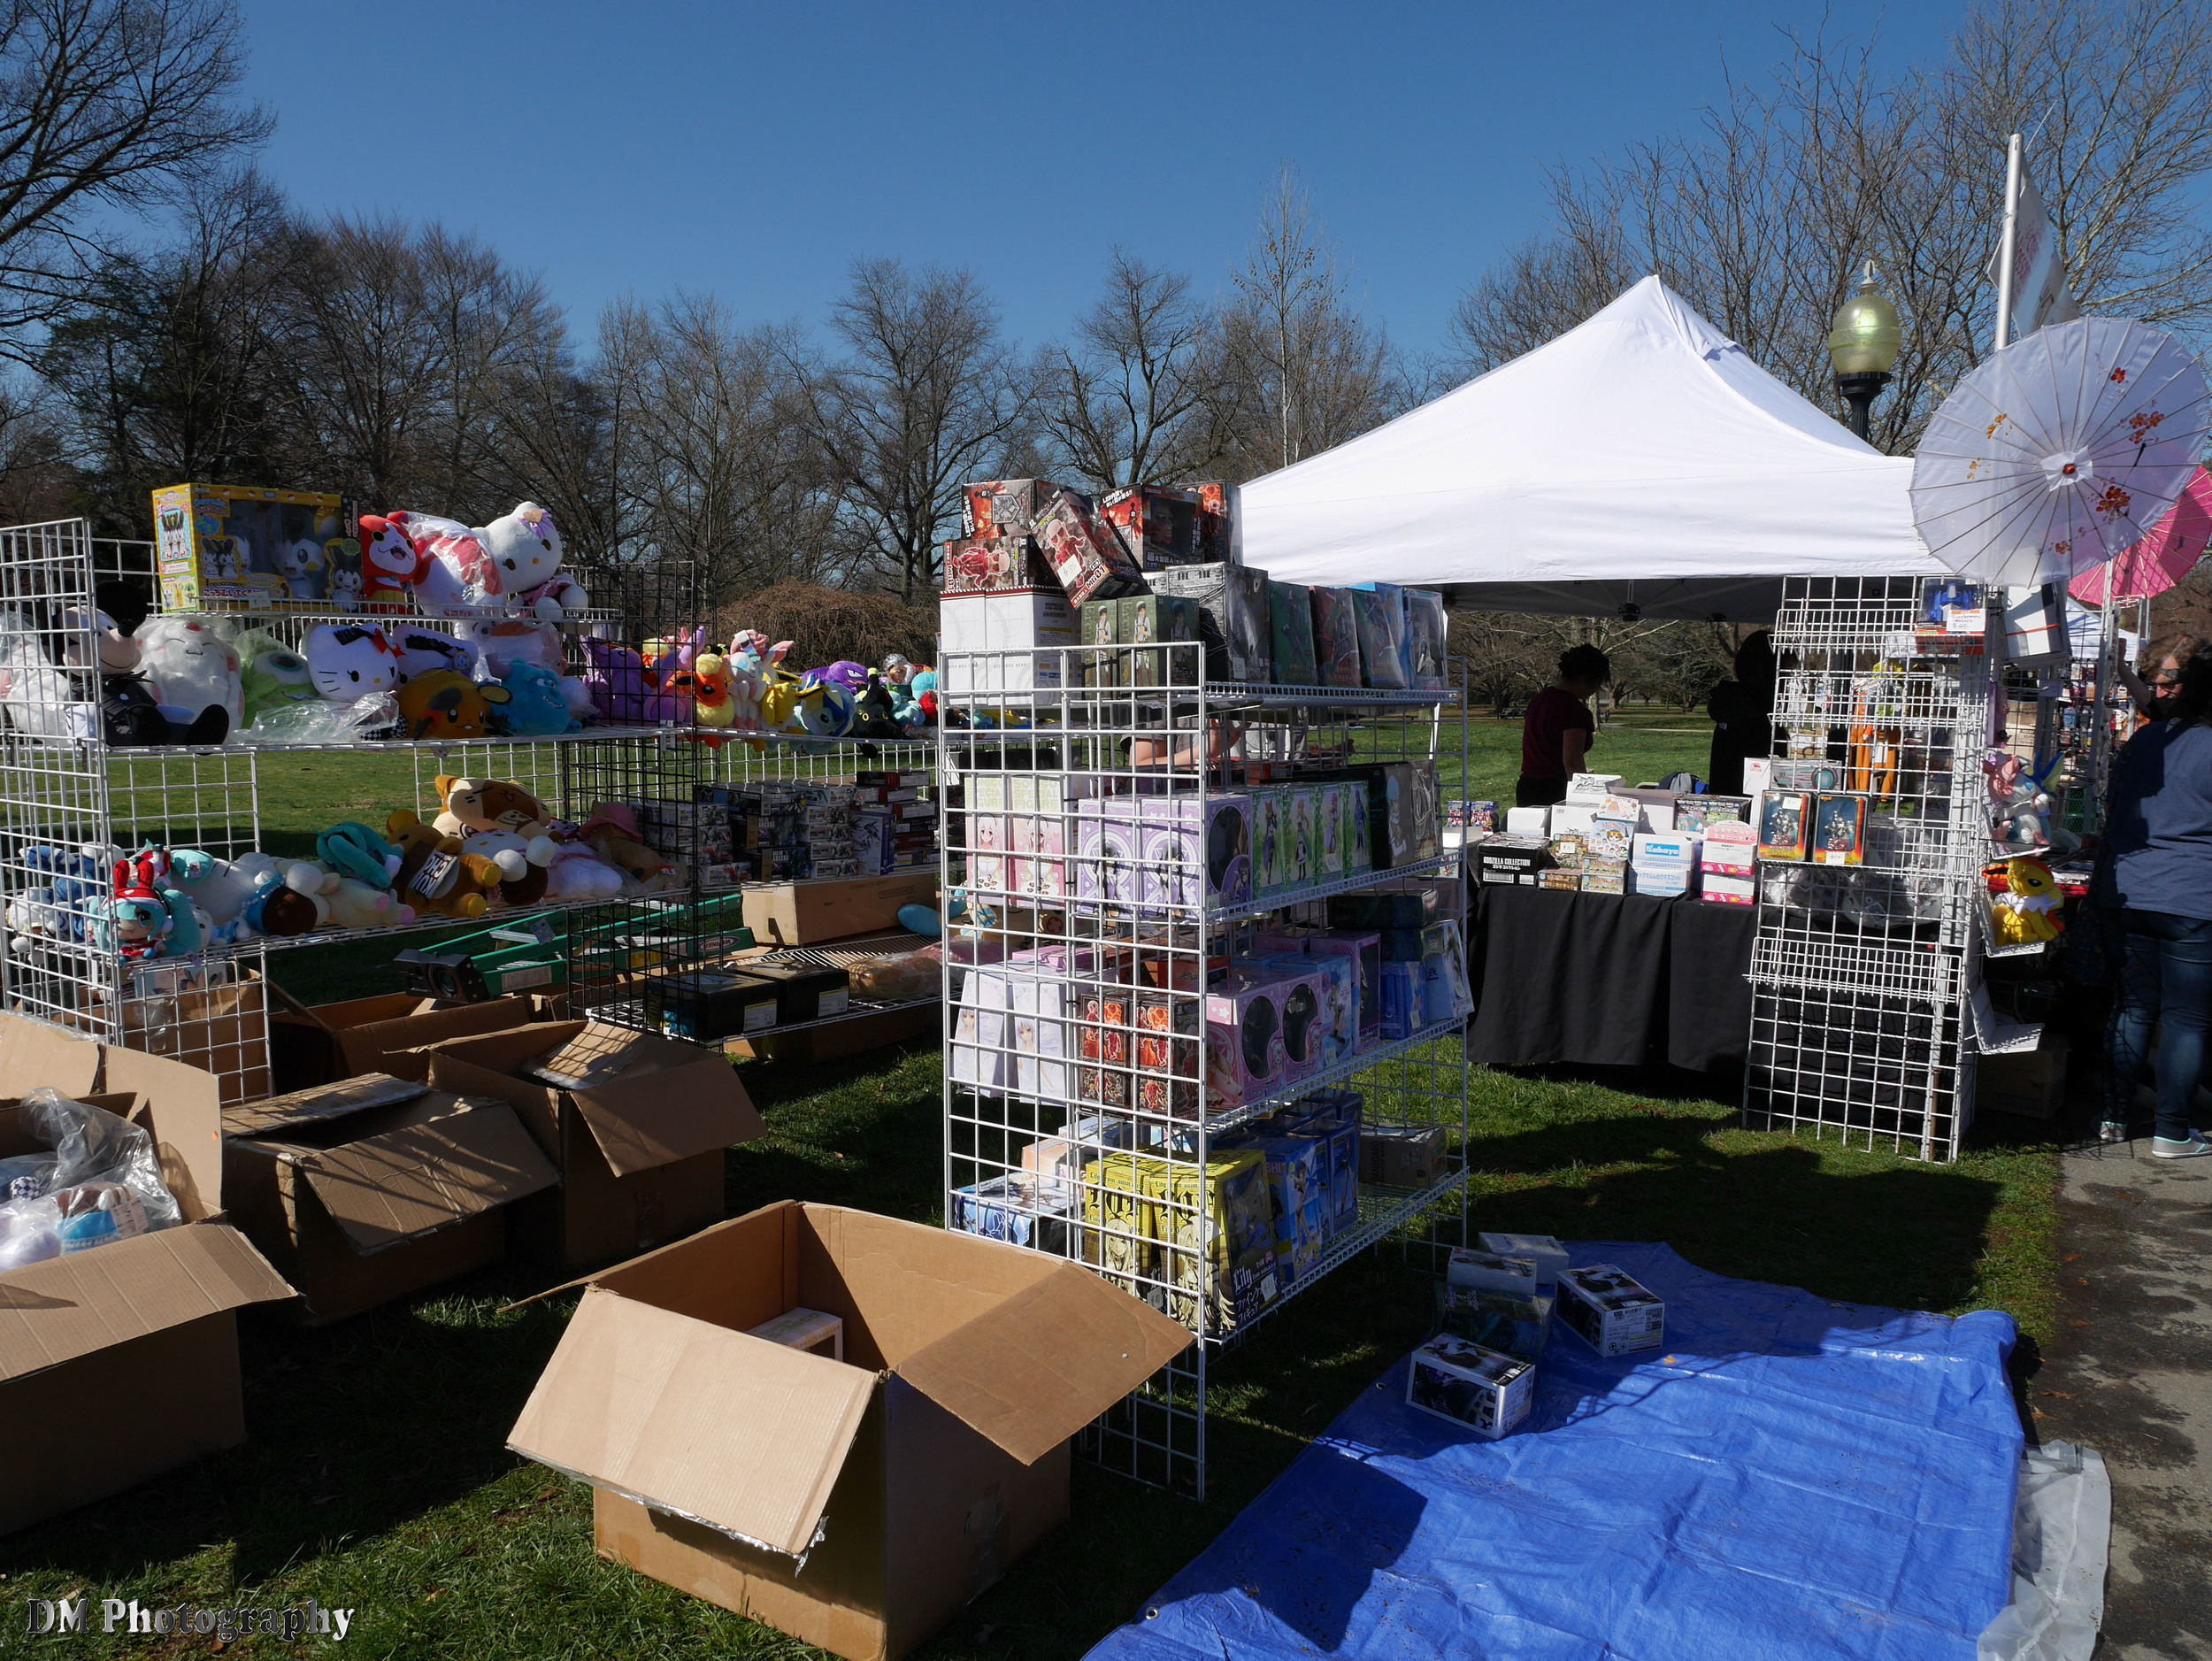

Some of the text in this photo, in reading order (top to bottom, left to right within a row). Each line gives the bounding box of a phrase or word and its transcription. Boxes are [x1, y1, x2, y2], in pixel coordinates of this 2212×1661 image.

[1086, 565, 1105, 591] MG01
[1084, 604, 1096, 640] Eren
[1121, 600, 1133, 638] Eren
[1014, 779, 1058, 788] SONCO
[1014, 788, 1059, 798] SPEIAL
[1014, 799, 1059, 809] FIGRE
[1646, 843, 1678, 855] Kabaya
[1483, 856, 1531, 867] GODZILLA COLLECTION
[1233, 1265, 1253, 1293] Lily
